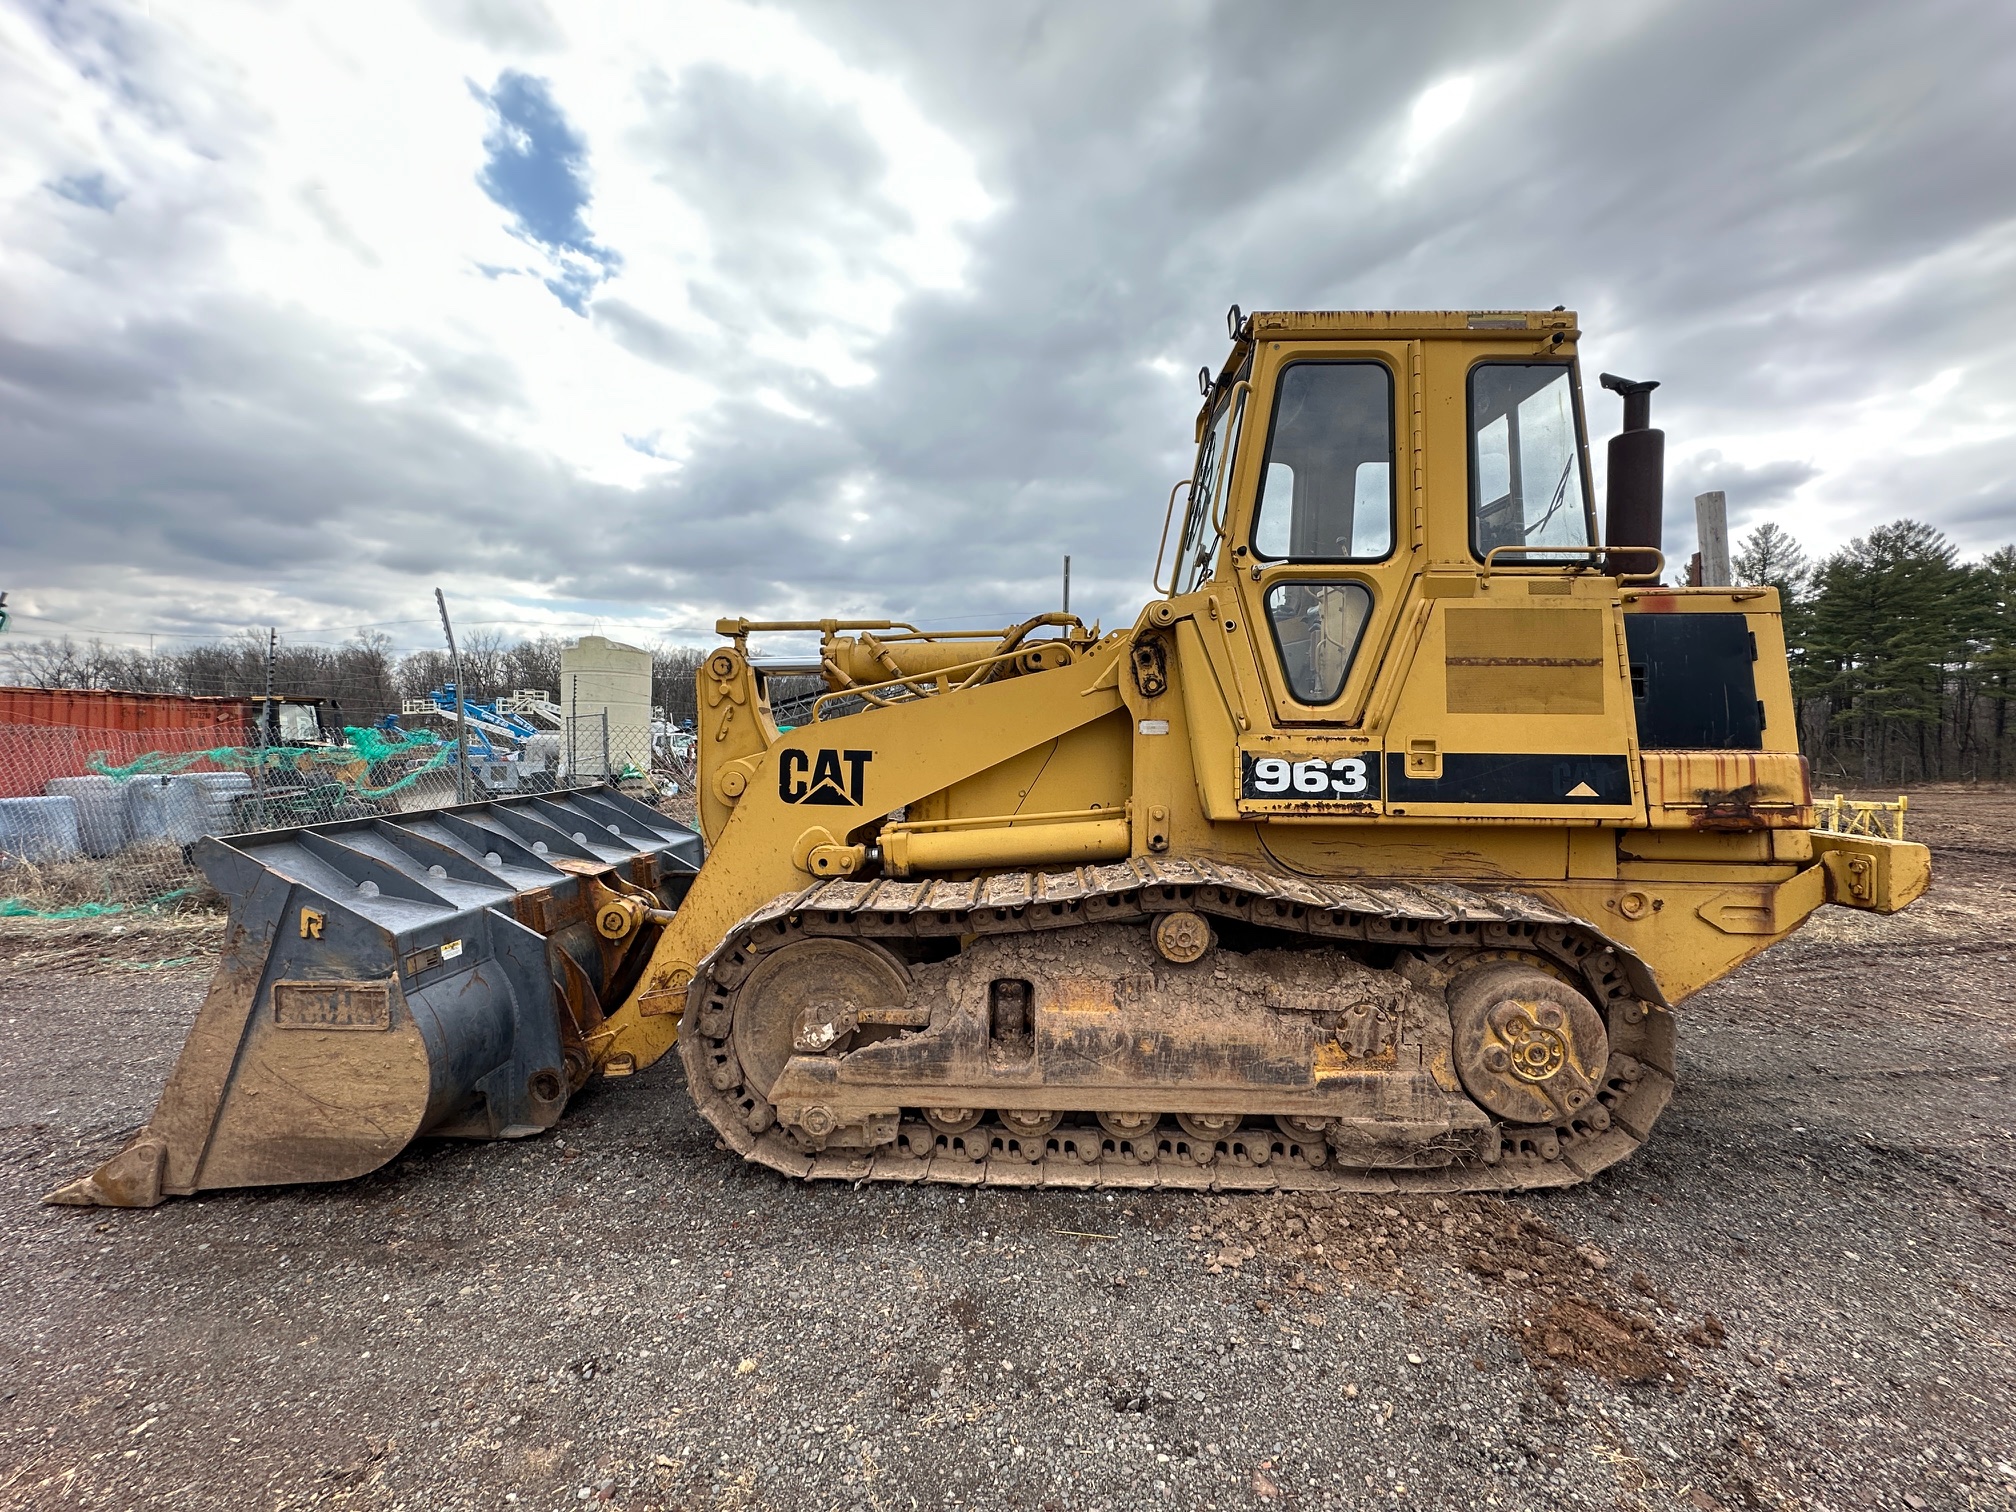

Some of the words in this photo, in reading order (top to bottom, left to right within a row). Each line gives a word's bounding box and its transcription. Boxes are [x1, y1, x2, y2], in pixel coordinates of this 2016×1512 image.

[779, 748, 873, 807] CAT
[1254, 758, 1367, 793] 963
[300, 906, 325, 939] R
